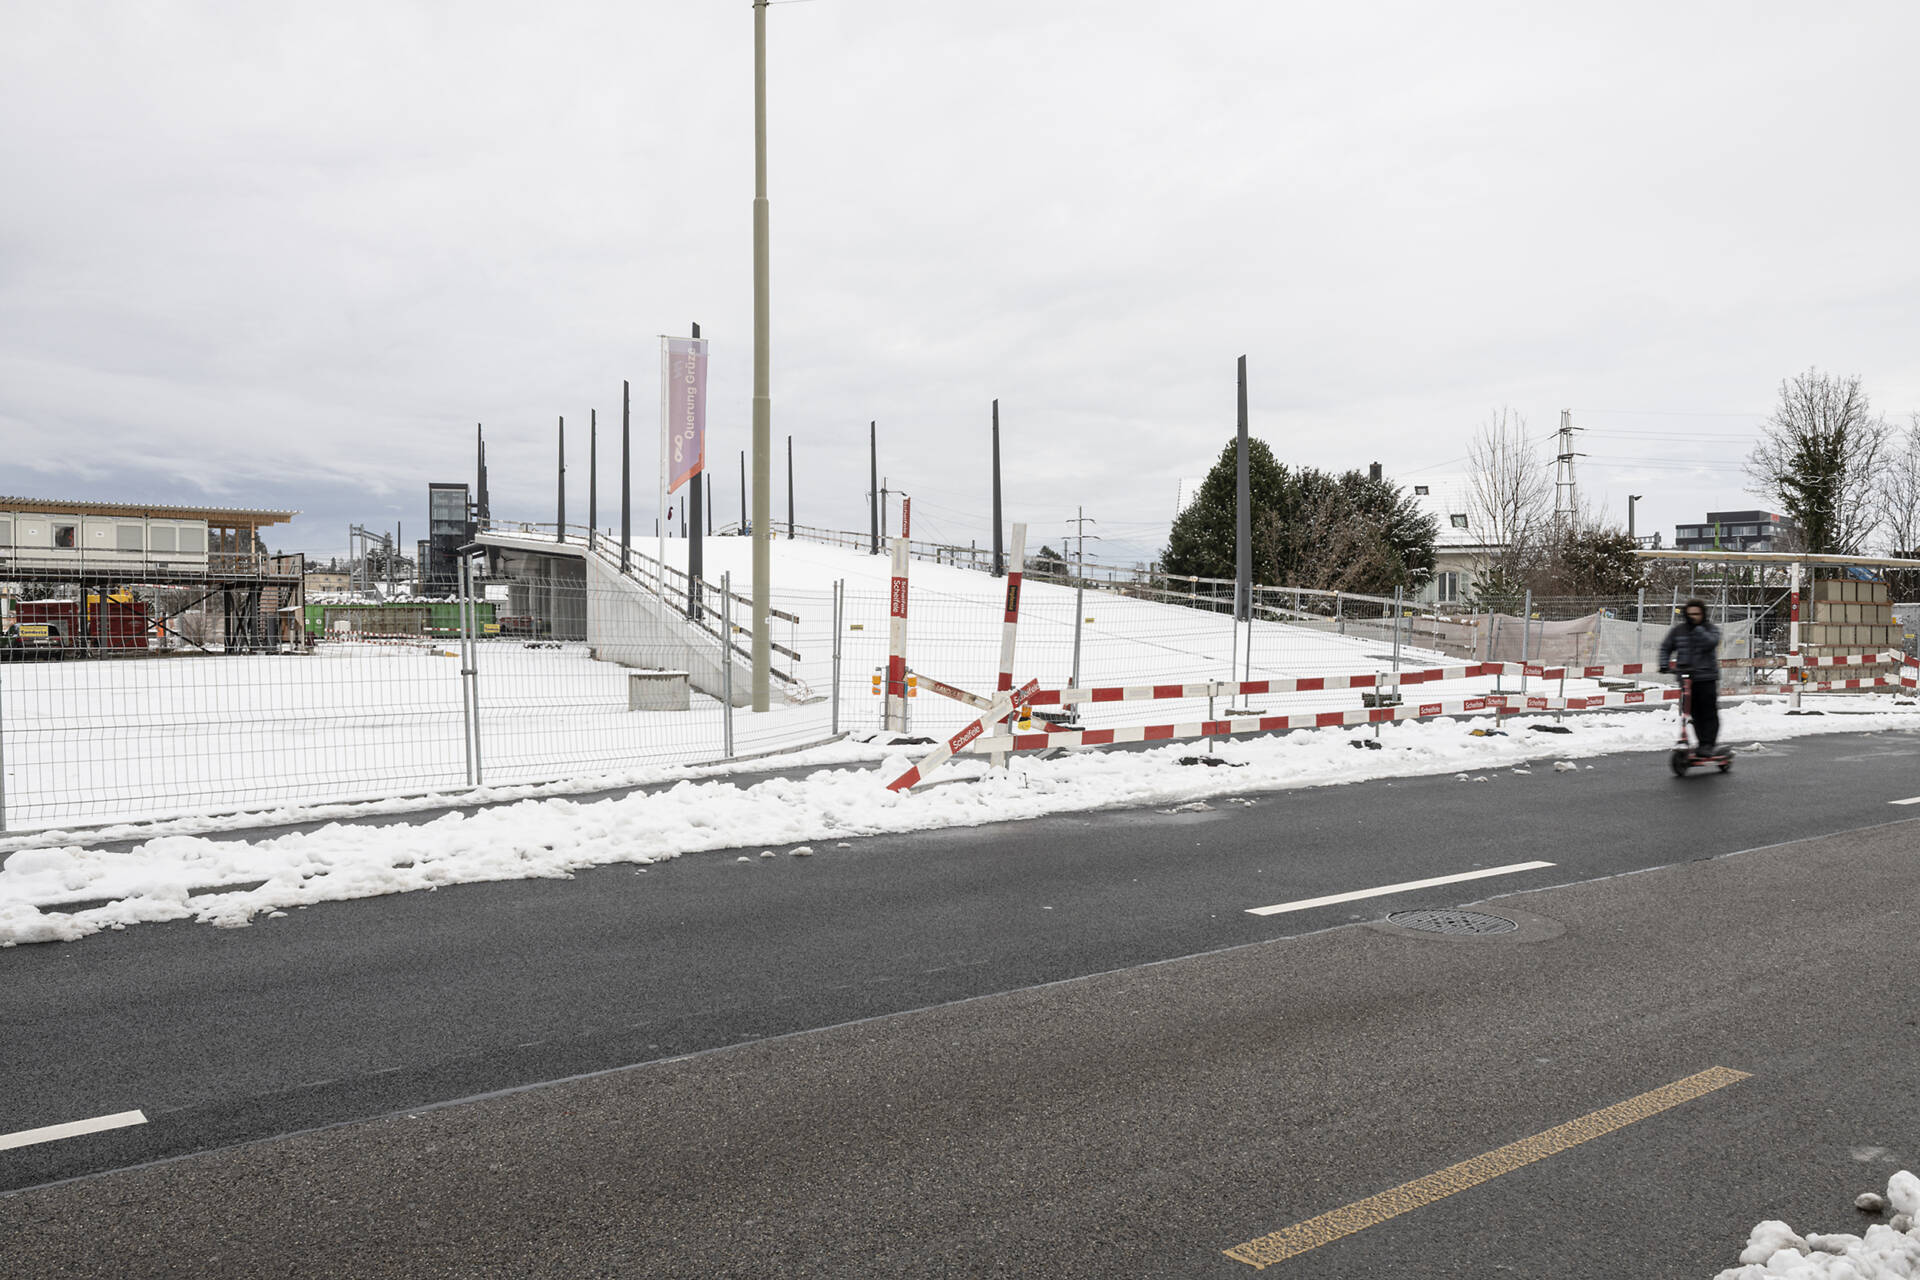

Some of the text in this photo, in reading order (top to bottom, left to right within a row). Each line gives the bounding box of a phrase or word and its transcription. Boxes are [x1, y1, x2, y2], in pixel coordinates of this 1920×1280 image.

[684, 347, 697, 439] Querung Grüze
[1420, 705, 1440, 714] Scheifele
[953, 727, 981, 750] Scheifele
